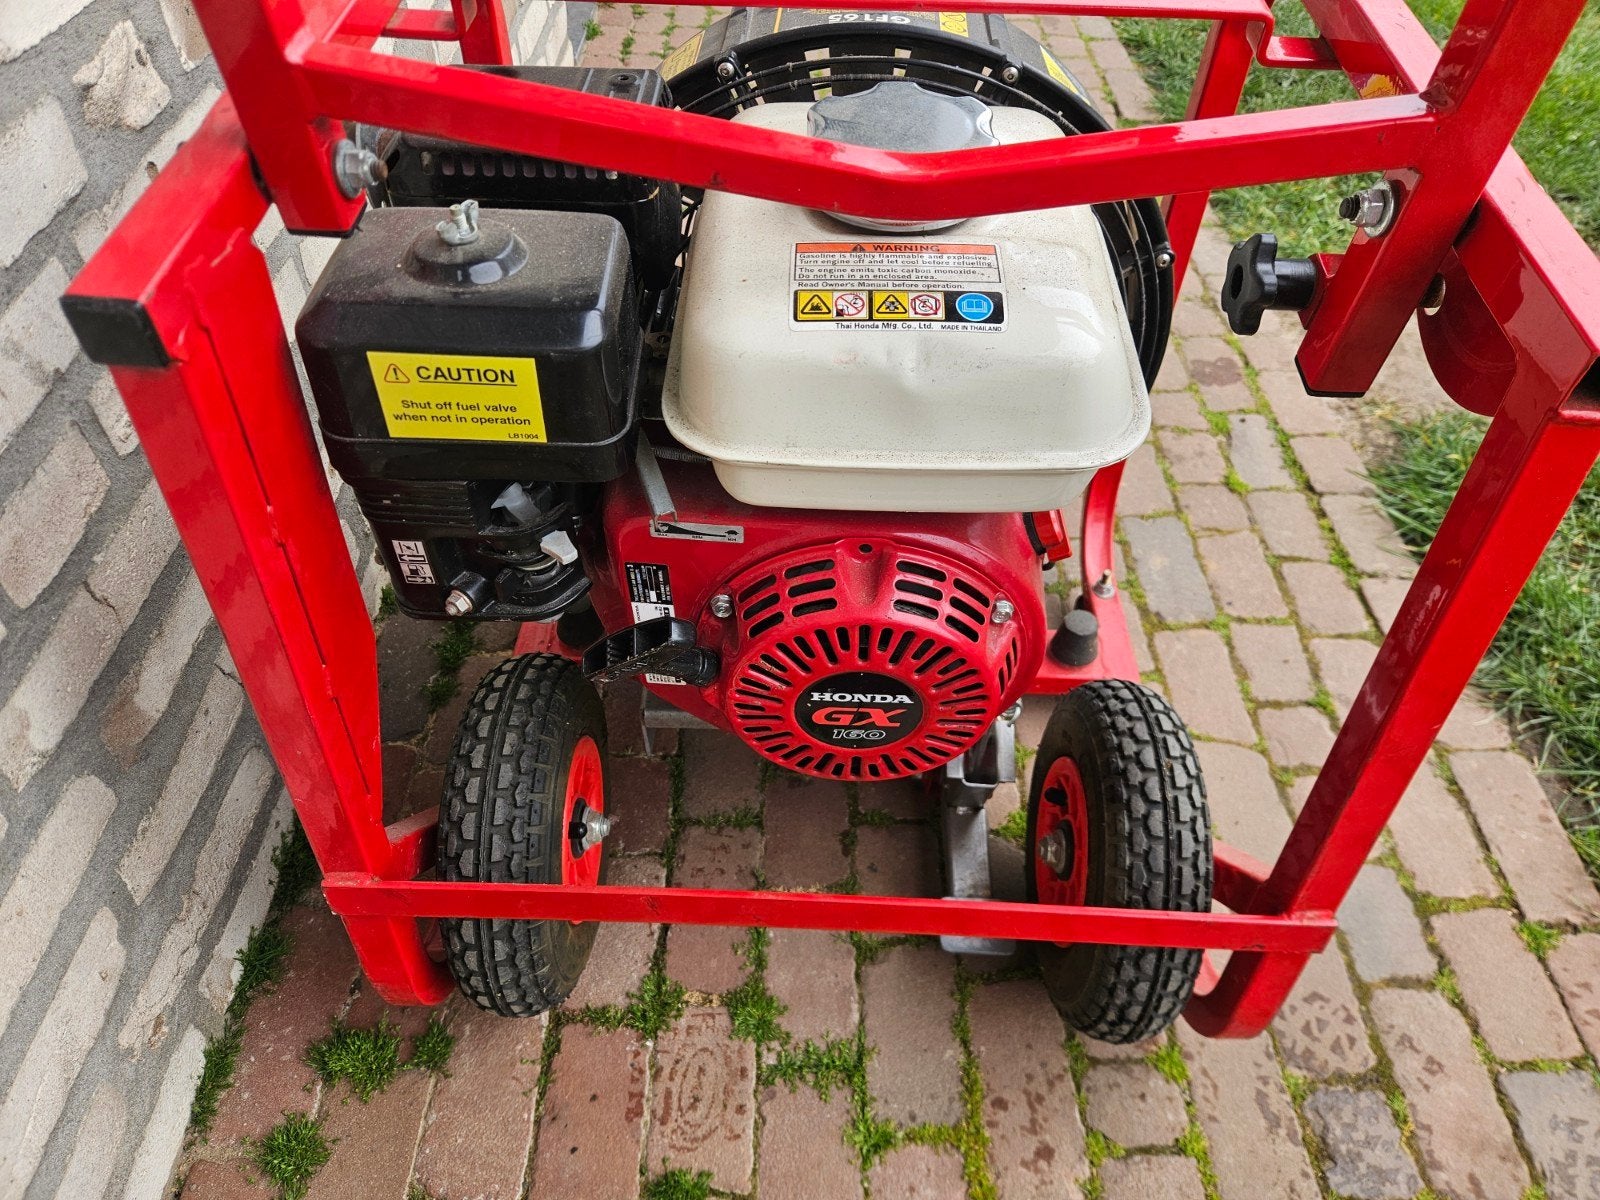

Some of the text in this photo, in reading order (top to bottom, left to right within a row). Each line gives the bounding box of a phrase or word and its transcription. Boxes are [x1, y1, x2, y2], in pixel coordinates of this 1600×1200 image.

[828, 13, 911, 24] GF165
[873, 244, 940, 252] WARNING
[921, 282, 965, 290] operation.
[854, 322, 880, 330] Honda
[881, 322, 899, 331] Mfg.
[901, 323, 917, 331] Co.,
[416, 366, 515, 384] CAUTION
[401, 400, 518, 413] Shut off fuel valve
[392, 412, 531, 426] when not in operation
[810, 692, 915, 704] HONDA
[811, 706, 908, 727] GX
[832, 728, 887, 740] 160
